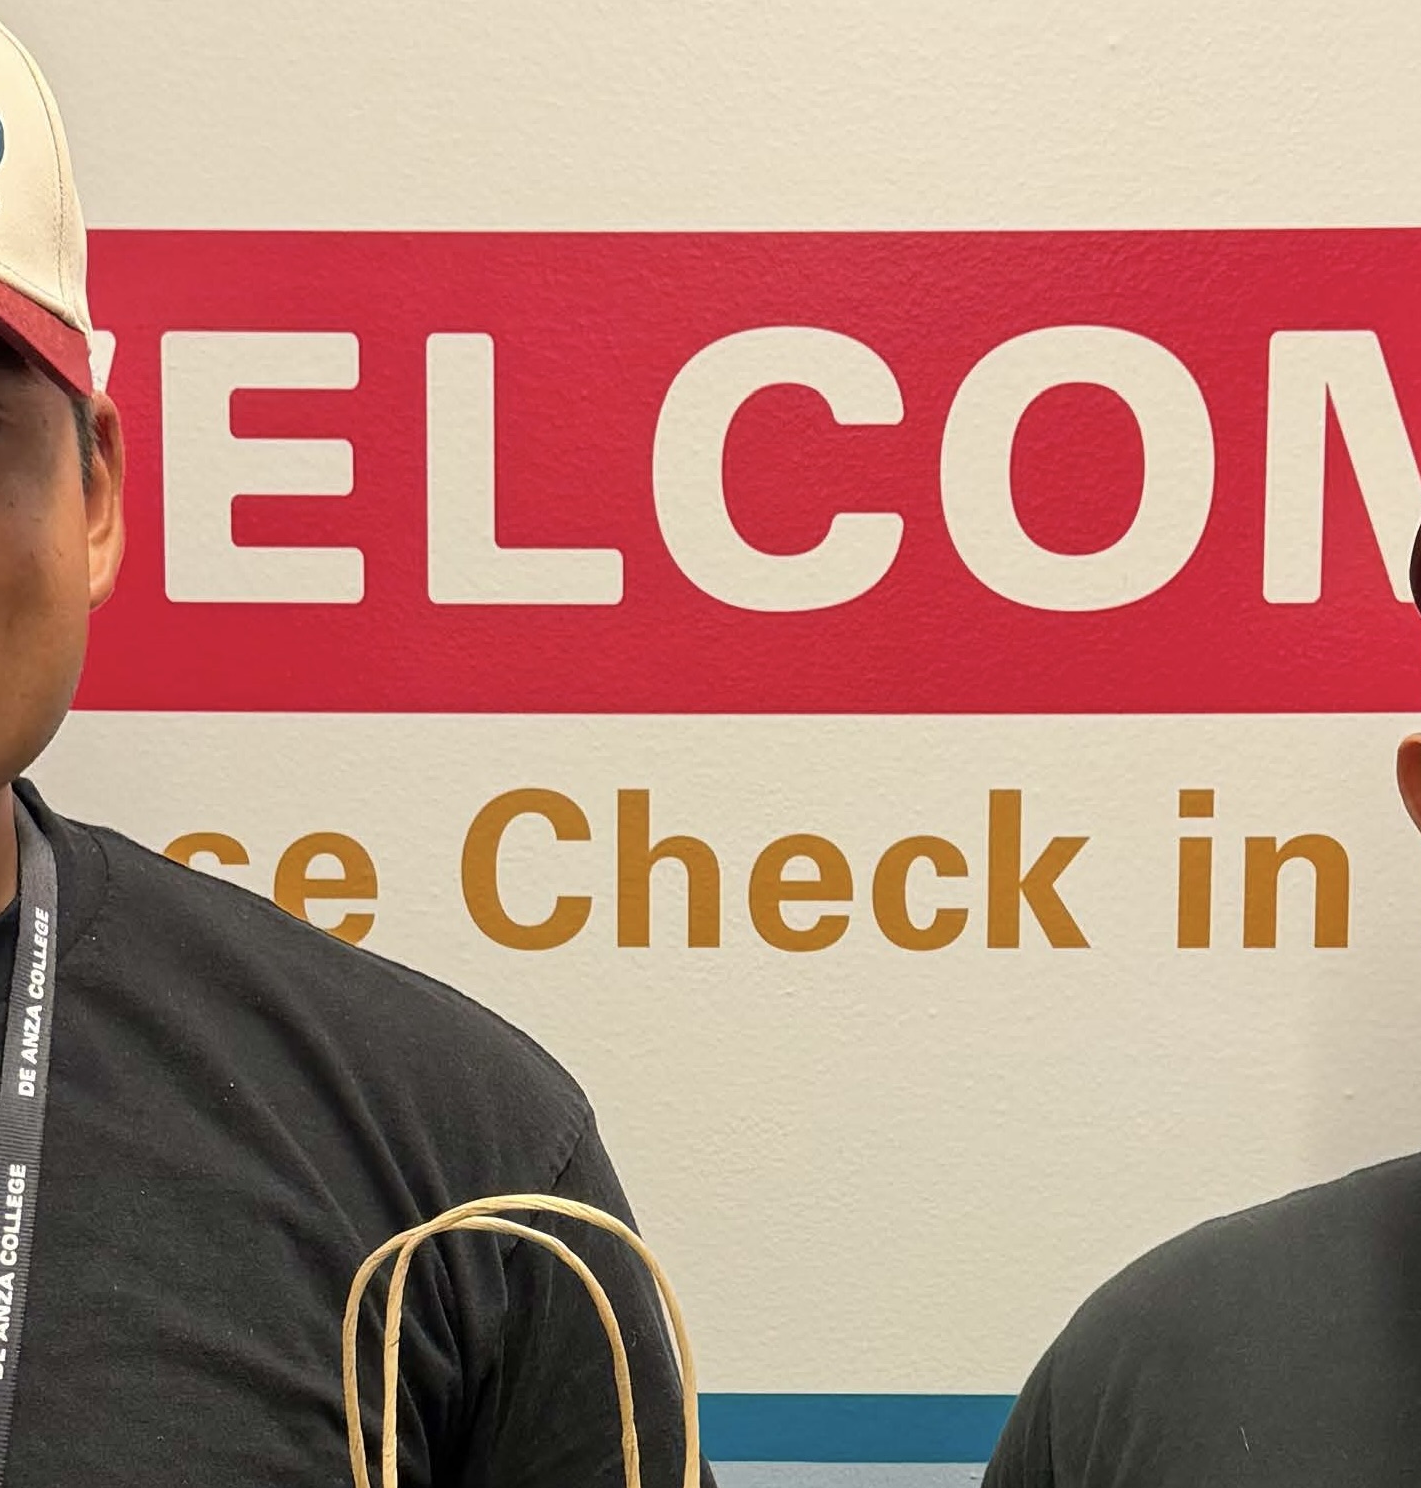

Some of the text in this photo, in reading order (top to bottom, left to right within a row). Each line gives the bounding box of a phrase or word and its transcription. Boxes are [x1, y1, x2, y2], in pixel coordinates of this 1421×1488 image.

[459, 788, 1087, 953] Check
[1178, 788, 1350, 949] in
[18, 907, 50, 1097] DE ANZA COLLEGE
[0, 1164, 27, 1266] COLLEGE
